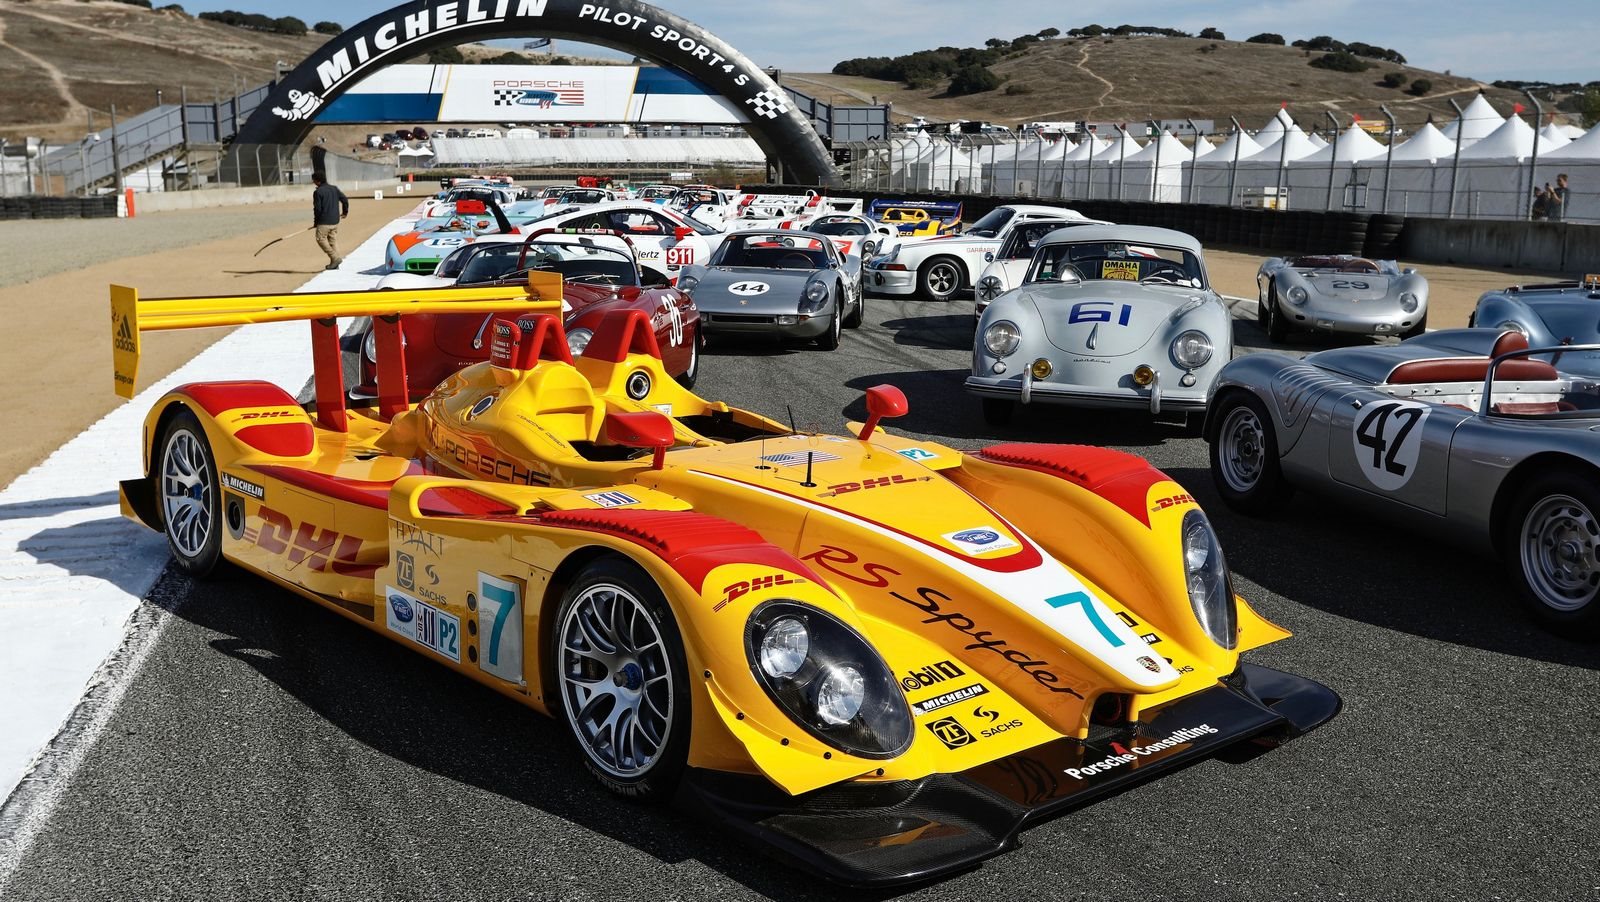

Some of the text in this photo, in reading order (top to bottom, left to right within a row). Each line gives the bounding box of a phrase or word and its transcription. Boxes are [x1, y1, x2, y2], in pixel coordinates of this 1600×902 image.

[316, 0, 548, 90] MICHELIN
[578, 4, 750, 86] PILOT SPORT 4 S
[493, 80, 584, 88] PORSCHE
[431, 238, 462, 246] 12
[668, 248, 693, 264] 911
[1105, 261, 1138, 269] OMAHA
[733, 283, 765, 292] 44
[1332, 280, 1370, 290] 29
[661, 293, 683, 347] 36
[1068, 302, 1132, 327] 61
[496, 325, 510, 335] BOSS
[115, 338, 135, 353] adidas
[240, 411, 295, 420] DHL
[1356, 402, 1424, 477] 42
[445, 439, 552, 487] PORSCHE
[899, 447, 934, 460] P2
[230, 475, 264, 497] MICHELIN
[827, 474, 919, 495] DHL
[256, 504, 386, 580] DHL
[396, 521, 444, 556] HYATT
[418, 586, 447, 606] SACHS
[723, 574, 794, 601] DHL
[482, 582, 516, 667] 7
[799, 544, 1085, 700] RS Spyder
[1044, 591, 1126, 648] 7
[439, 617, 457, 655] P2
[936, 660, 964, 679] 1
[921, 684, 984, 710] MICHELIN
[935, 722, 968, 743] ZF
[980, 719, 1024, 738] SACHS
[1063, 723, 1219, 780] Porsche Consulting
